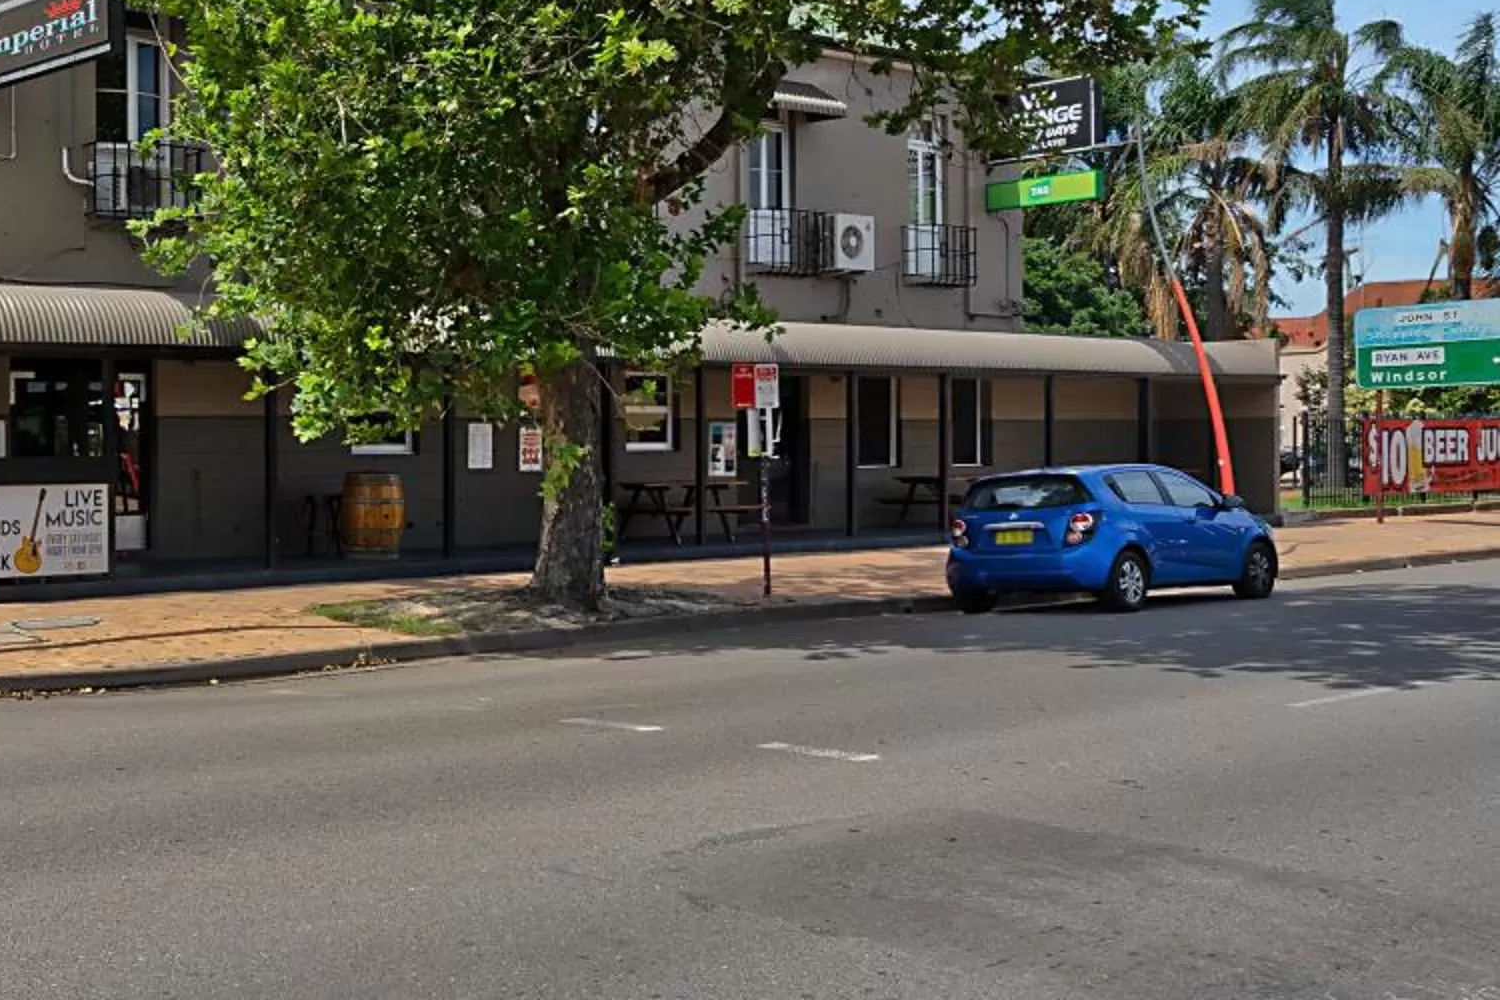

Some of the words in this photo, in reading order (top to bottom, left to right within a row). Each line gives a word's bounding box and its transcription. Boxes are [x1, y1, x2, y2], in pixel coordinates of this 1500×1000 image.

[1398, 311, 1433, 322] JOHN
[1375, 352, 1408, 363] RYAN
[1415, 350, 1439, 361] AVE
[1371, 370, 1448, 383] Windsor
[1368, 423, 1407, 484] $10
[1423, 429, 1469, 463] BEER
[1477, 428, 1500, 462] JU
[65, 489, 103, 507] LIVE
[45, 509, 103, 528] MUSIC
